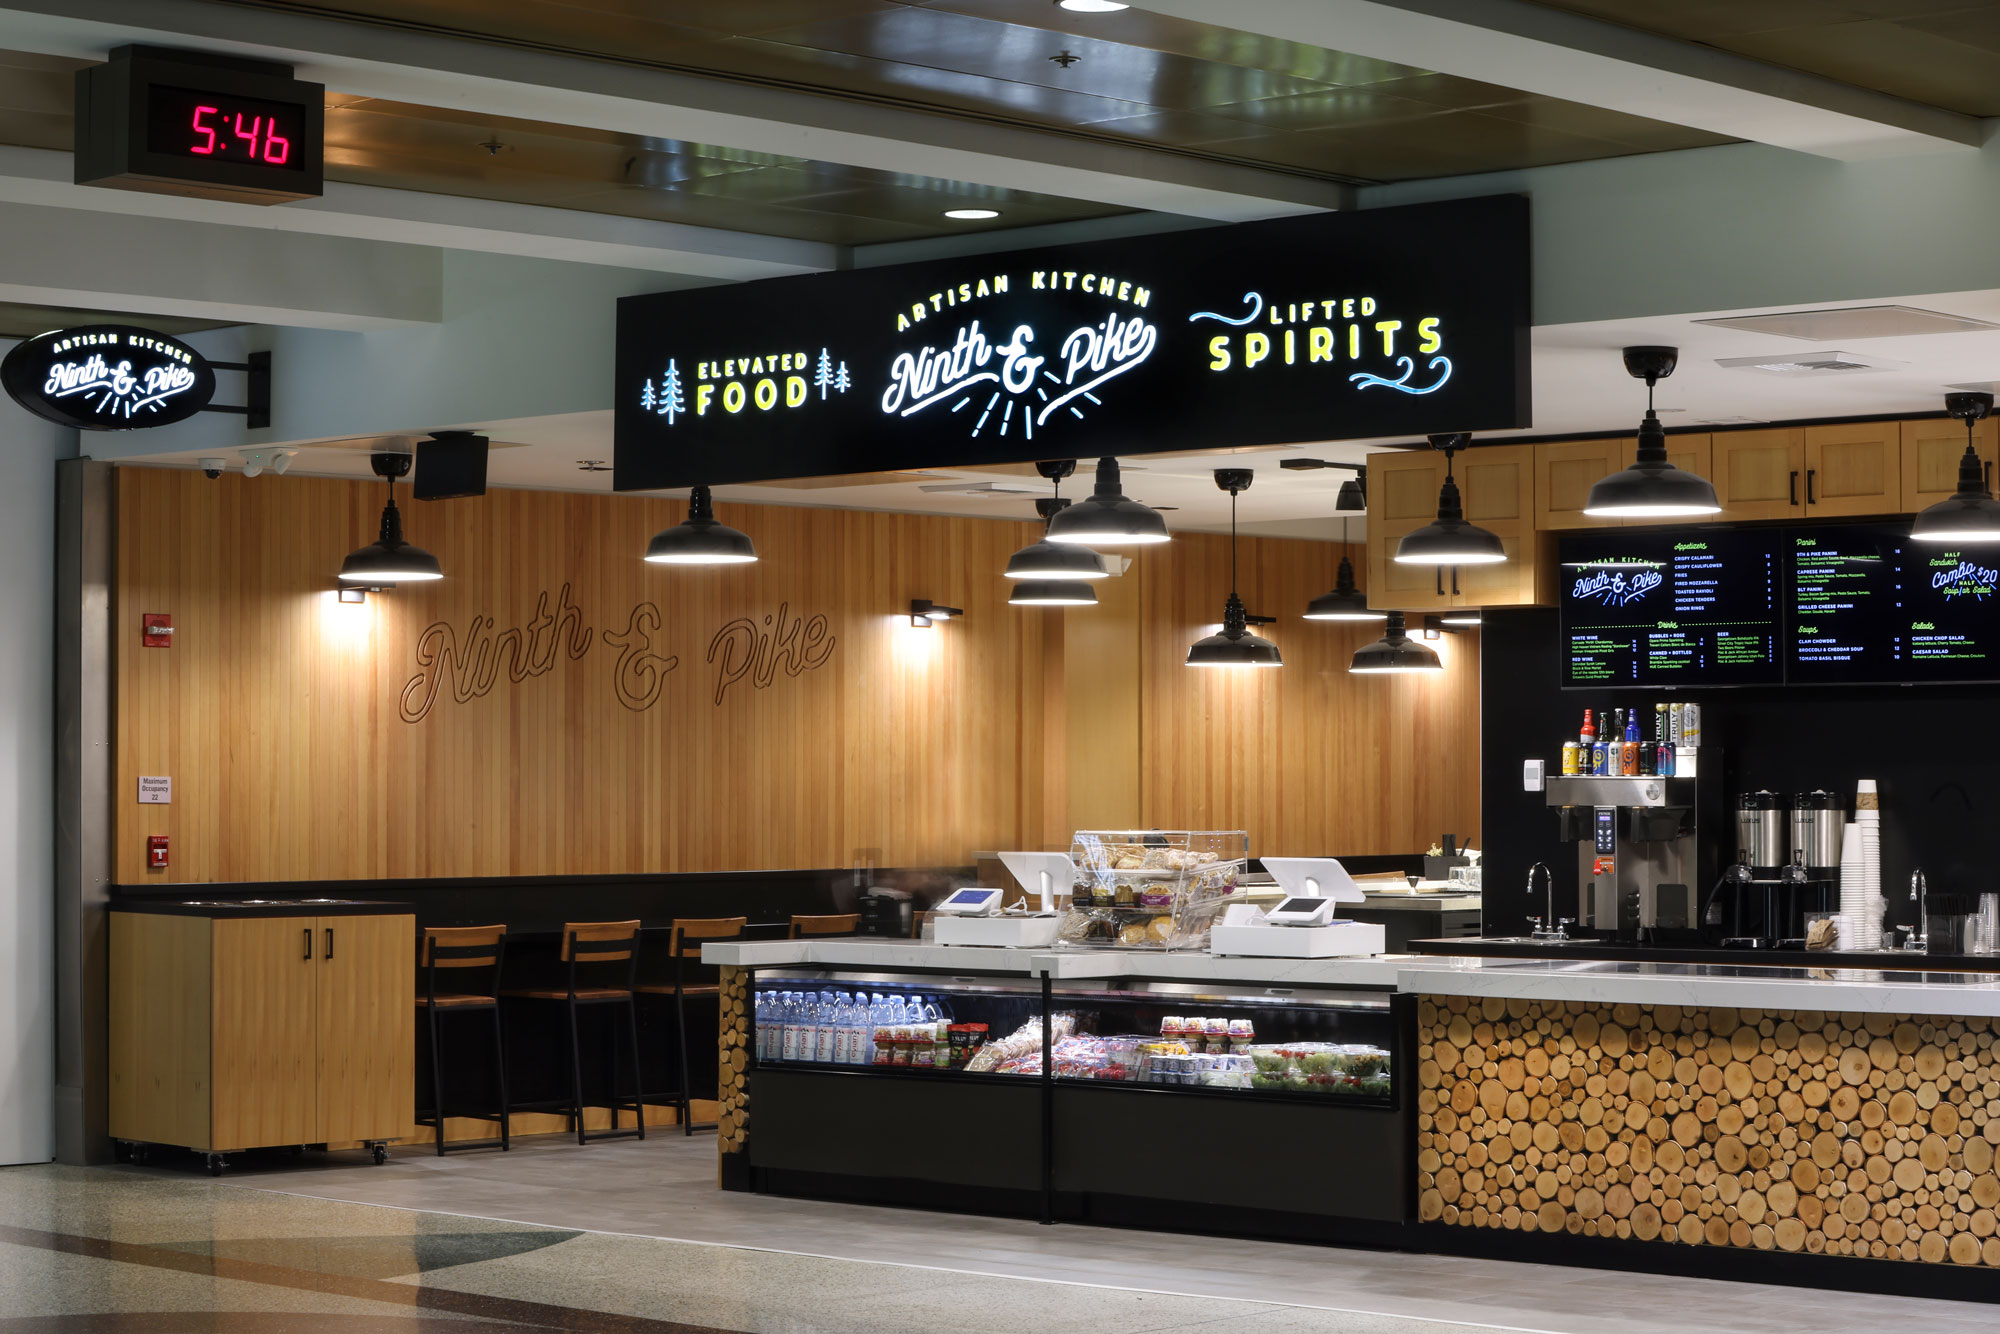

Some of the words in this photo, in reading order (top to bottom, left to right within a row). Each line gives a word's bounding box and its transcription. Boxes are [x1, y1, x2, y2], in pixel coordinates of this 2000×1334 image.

[190, 106, 289, 164] 5:46
[897, 274, 1008, 332] ARTISAN
[1032, 271, 1151, 308] KITCHEN
[1270, 297, 1376, 325] LIFTED
[53, 333, 118, 353] ARTISAN
[129, 335, 192, 364] KITCHEN
[1209, 317, 1441, 372] SPIRITS
[698, 352, 807, 380] ELEVATED
[881, 319, 992, 414] Ninth
[995, 324, 1045, 394] &
[1050, 312, 1157, 400] Pike
[44, 353, 108, 394] Ninth
[109, 360, 137, 395] &
[138, 363, 195, 404] Pike
[697, 376, 807, 416] FOOD
[1674, 542, 1708, 551] Appetizers
[1796, 538, 1816, 546] Panini
[1573, 570, 1609, 597] Ninth
[1610, 572, 1626, 593] &
[1628, 570, 1662, 598] Pike
[1932, 561, 1976, 588] Combo
[1977, 567, 1998, 583] $20
[1943, 586, 1959, 596] Soup
[1657, 621, 1679, 629] Drinks
[1798, 626, 1818, 634] Soups
[1912, 622, 1935, 630] Salads
[399, 582, 593, 724] Ninth
[603, 601, 679, 712] &
[706, 600, 836, 707] Pike
[142, 785, 168, 793] Occupancy
